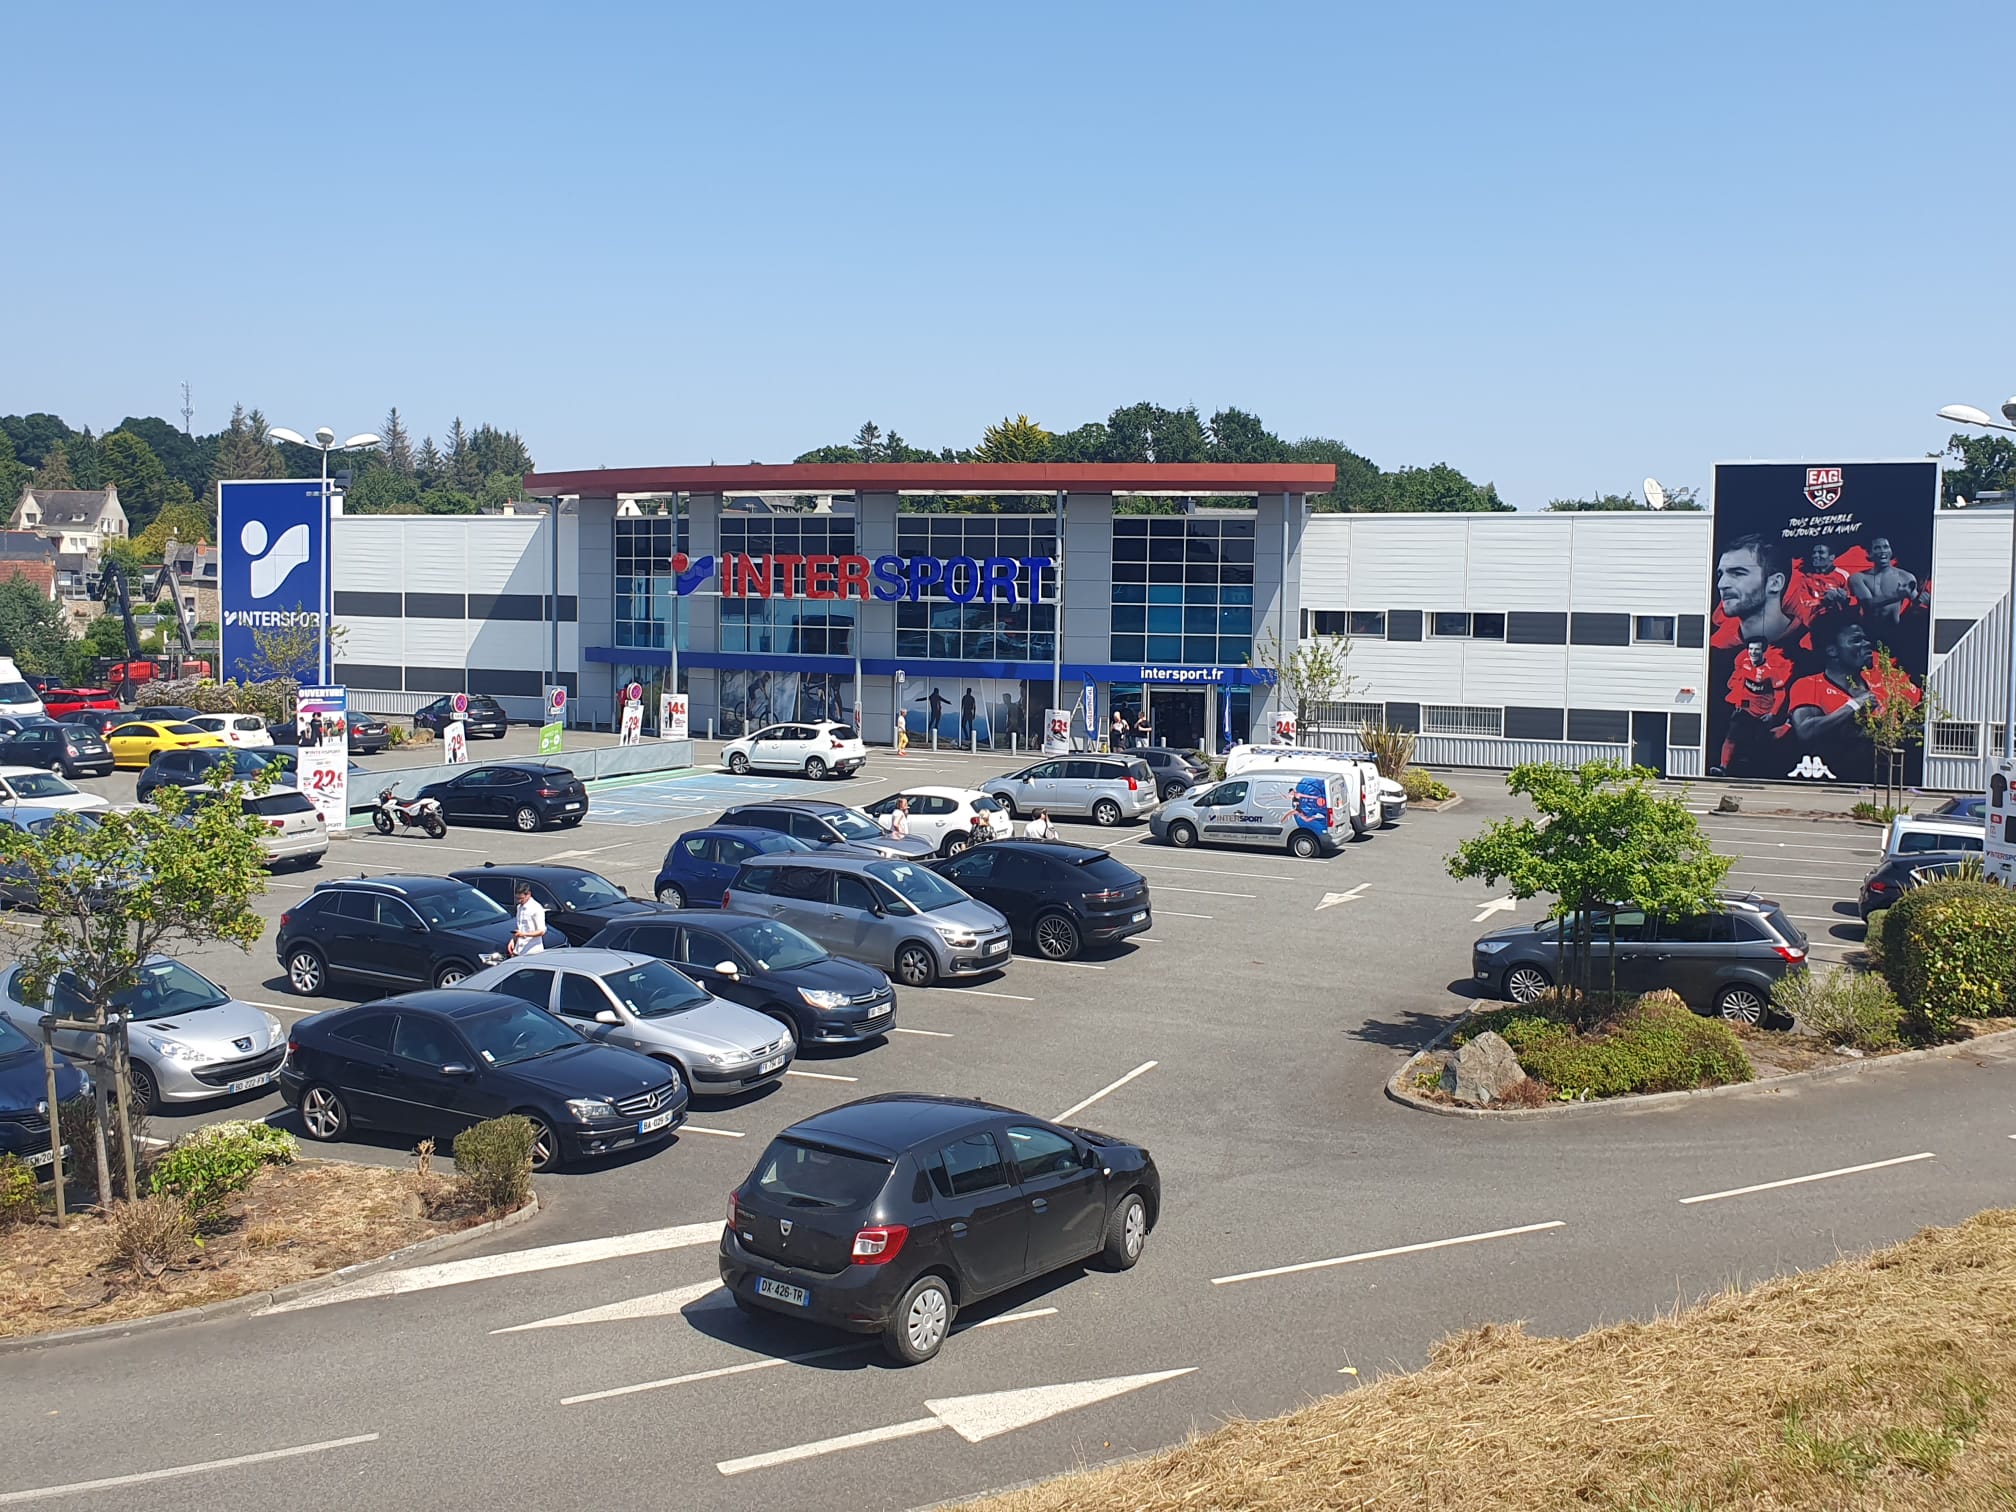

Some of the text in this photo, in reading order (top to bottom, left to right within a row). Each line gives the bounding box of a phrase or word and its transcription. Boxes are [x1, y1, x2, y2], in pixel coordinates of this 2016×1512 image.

[1809, 470, 1838, 484] EAG
[1789, 513, 1853, 527] TOUS ENSEMBLE
[1782, 522, 1863, 538] TOUJOURS EN AVANT
[722, 552, 1052, 604] INTERSPORT
[238, 610, 329, 628] INTERSPOR
[1140, 666, 1224, 682] intersport.fr
[298, 688, 345, 698] OUVERTURE
[1216, 814, 1263, 823] INTERSPORT
[761, 1280, 803, 1302] DX-426-TR
